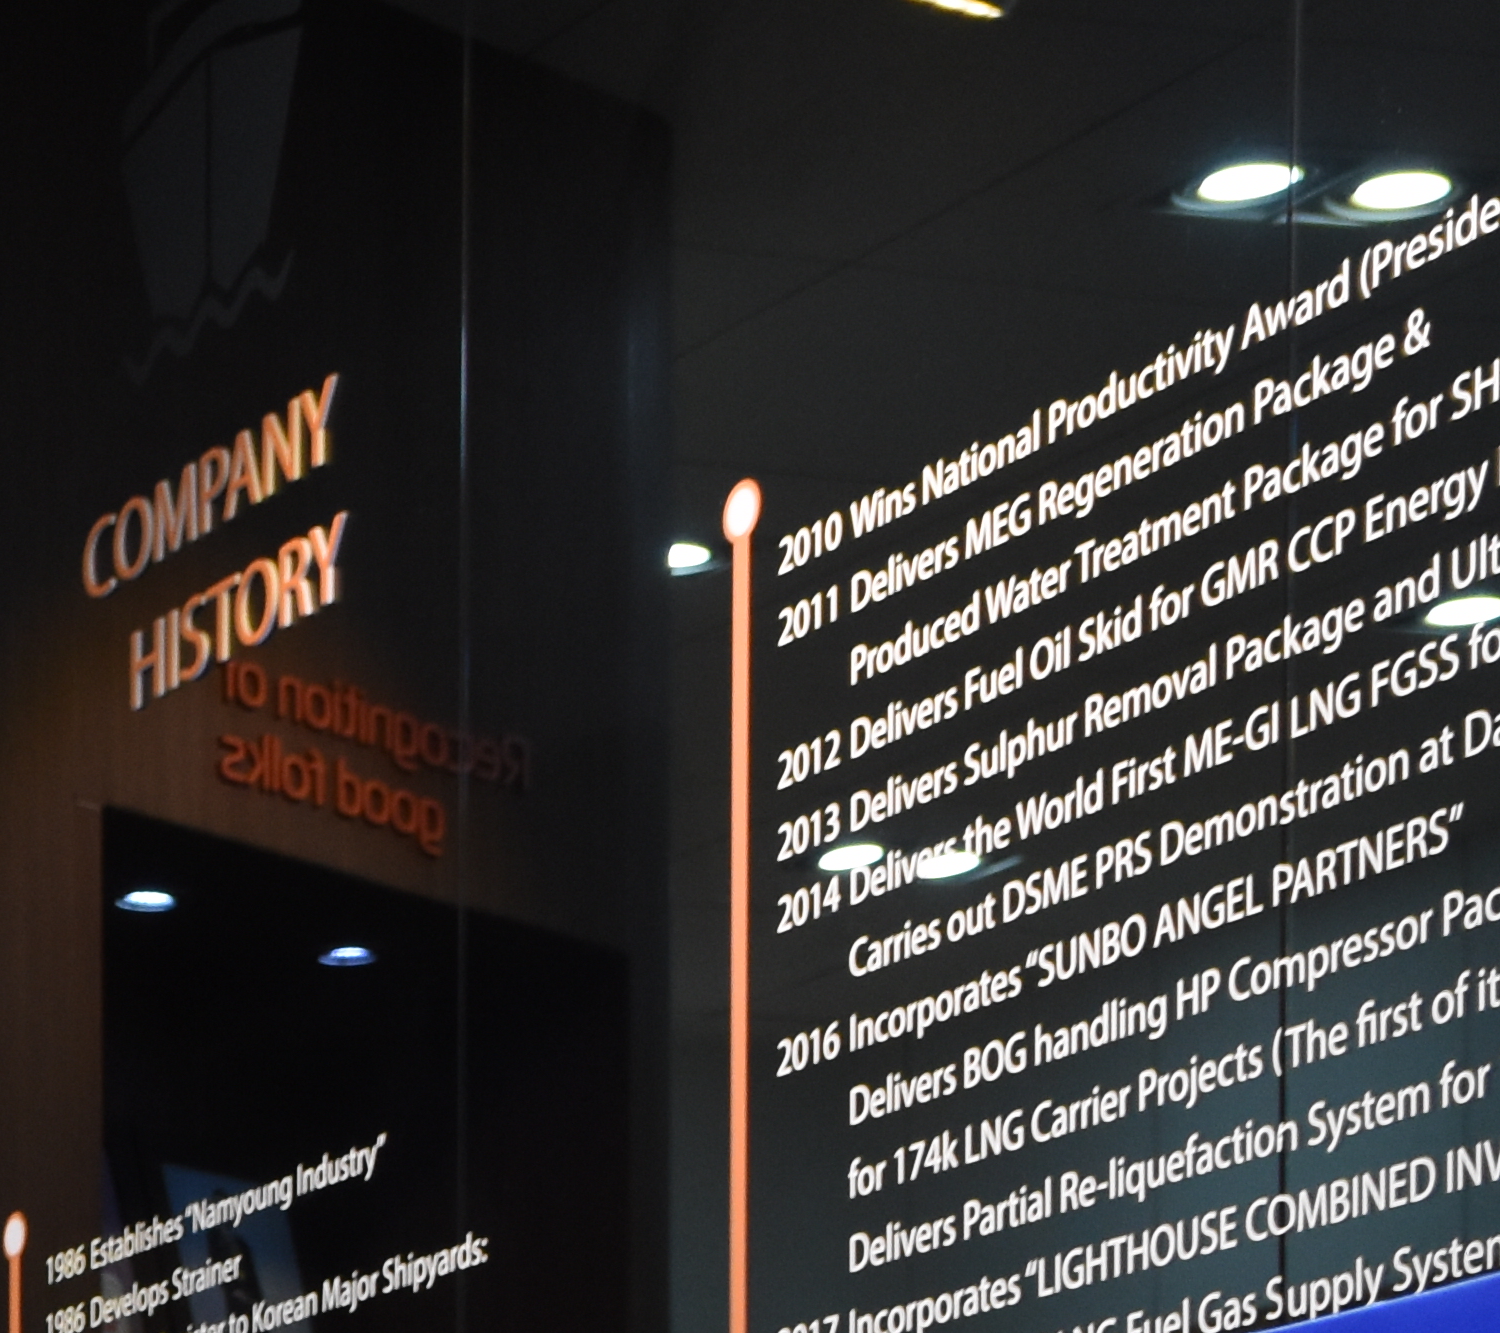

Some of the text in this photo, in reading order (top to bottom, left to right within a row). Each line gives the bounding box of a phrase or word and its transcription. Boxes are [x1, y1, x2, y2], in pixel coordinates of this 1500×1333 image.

[82, 373, 339, 598] COMPANY
[777, 257, 1350, 577] 2010 Wins National Productivity Award
[777, 307, 1431, 648] 2011 Delivers MEG Regeneration Package &
[130, 510, 349, 710] HISTORY
[776, 459, 1489, 791] 2012 Delivers Fuel Oil Skid for GMR CCP Energy
[776, 880, 841, 936] 2014
[961, 814, 1012, 863] the
[1015, 767, 1104, 841] World
[1111, 745, 1177, 806] First
[1183, 700, 1279, 778] ME-GI
[1290, 671, 1362, 740] LNG
[1371, 631, 1460, 708] FGSS
[776, 1020, 841, 1078] 2016
[849, 964, 1022, 1053] Incorporates
[1152, 873, 1264, 949] ANGEL
[849, 908, 1434, 1127] Delivers BOG handling HP Compressor
[45, 1243, 87, 1286] 1986
[90, 1213, 184, 1271] Establishes
[89, 1279, 169, 1329] Develops
[171, 1254, 242, 1302] Strainer
[321, 1269, 380, 1314] Major
[381, 1231, 489, 1295] Shipyards:
[1245, 1155, 1437, 1243] COMBINED
